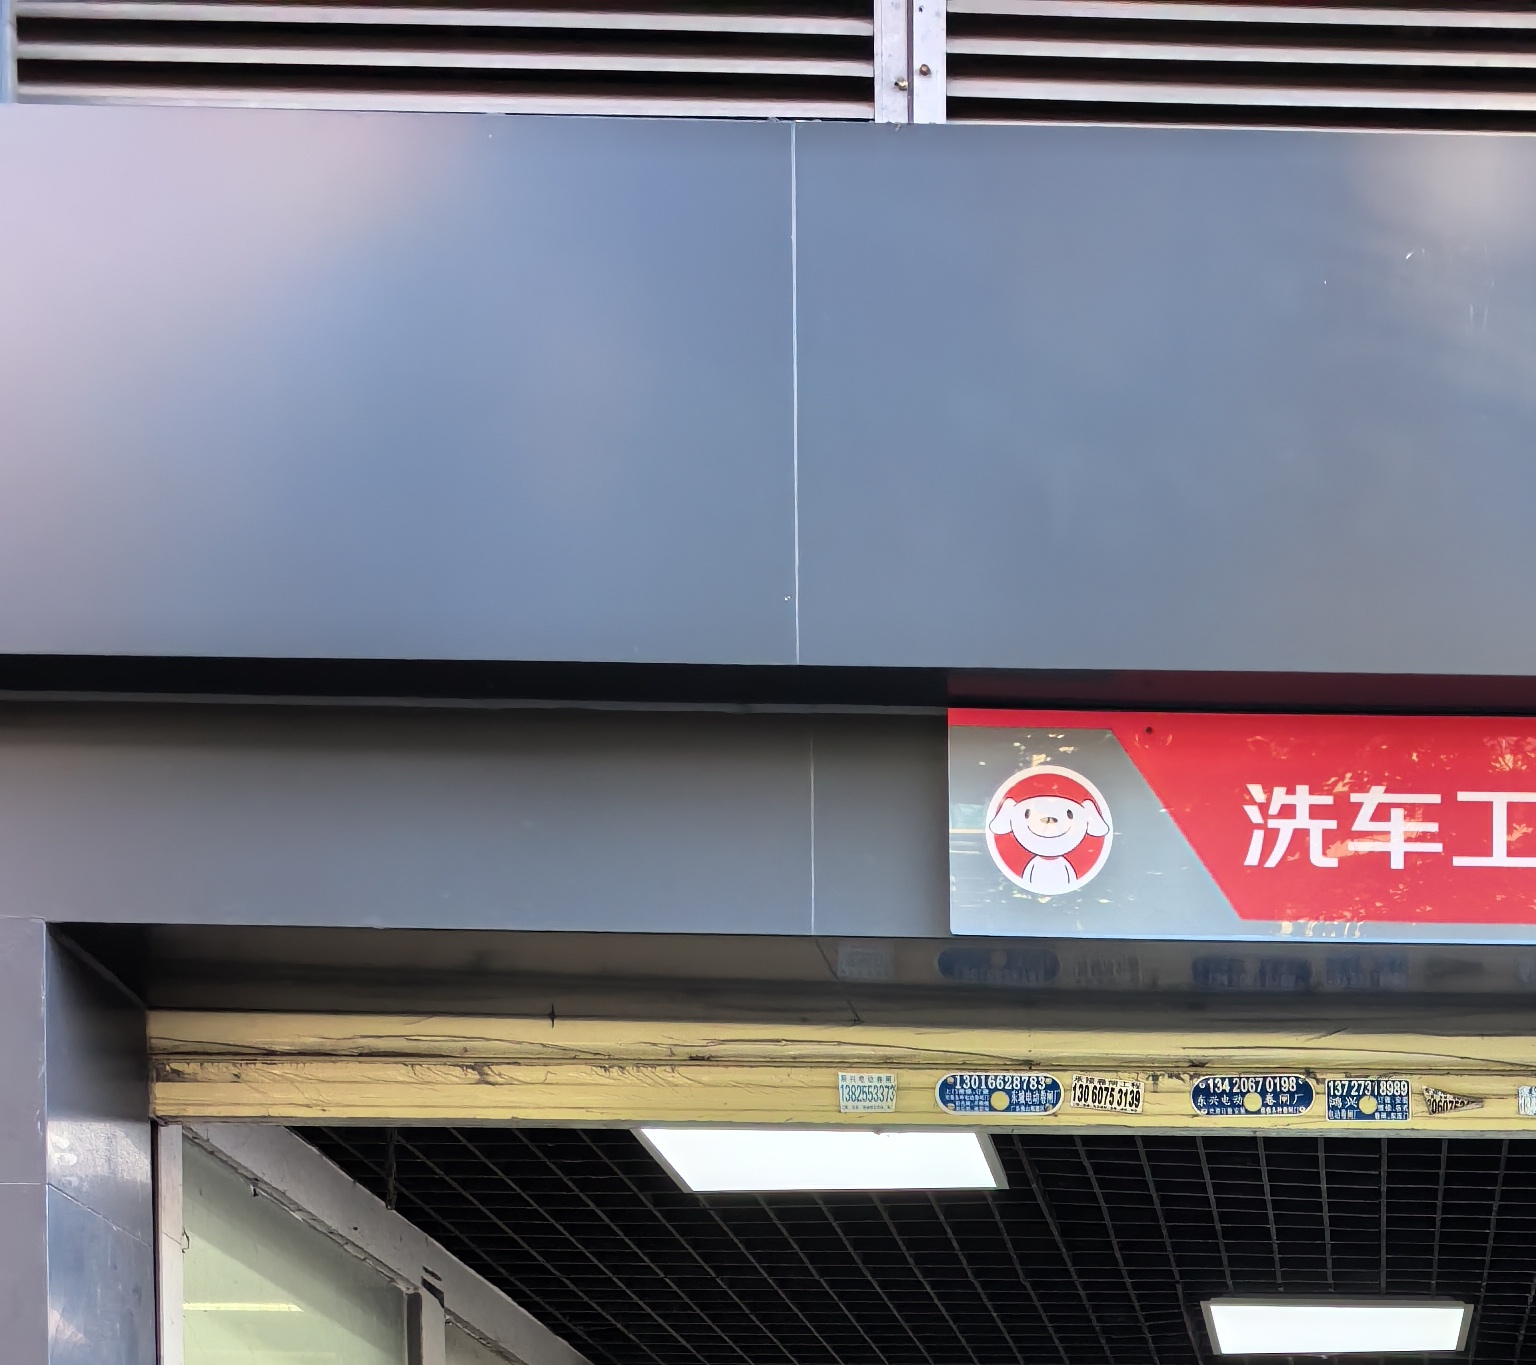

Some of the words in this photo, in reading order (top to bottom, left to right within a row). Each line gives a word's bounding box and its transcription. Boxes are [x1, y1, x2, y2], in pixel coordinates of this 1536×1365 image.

[955, 1075, 1046, 1090] 13016628783
[1208, 1078, 1231, 1093] 134
[1233, 1077, 1264, 1093] 2067
[1266, 1077, 1297, 1092] 0198
[1329, 1081, 1349, 1096] 137
[1072, 1082, 1090, 1103] 130
[1091, 1085, 1115, 1106] 6075
[1117, 1088, 1141, 1109] 3139
